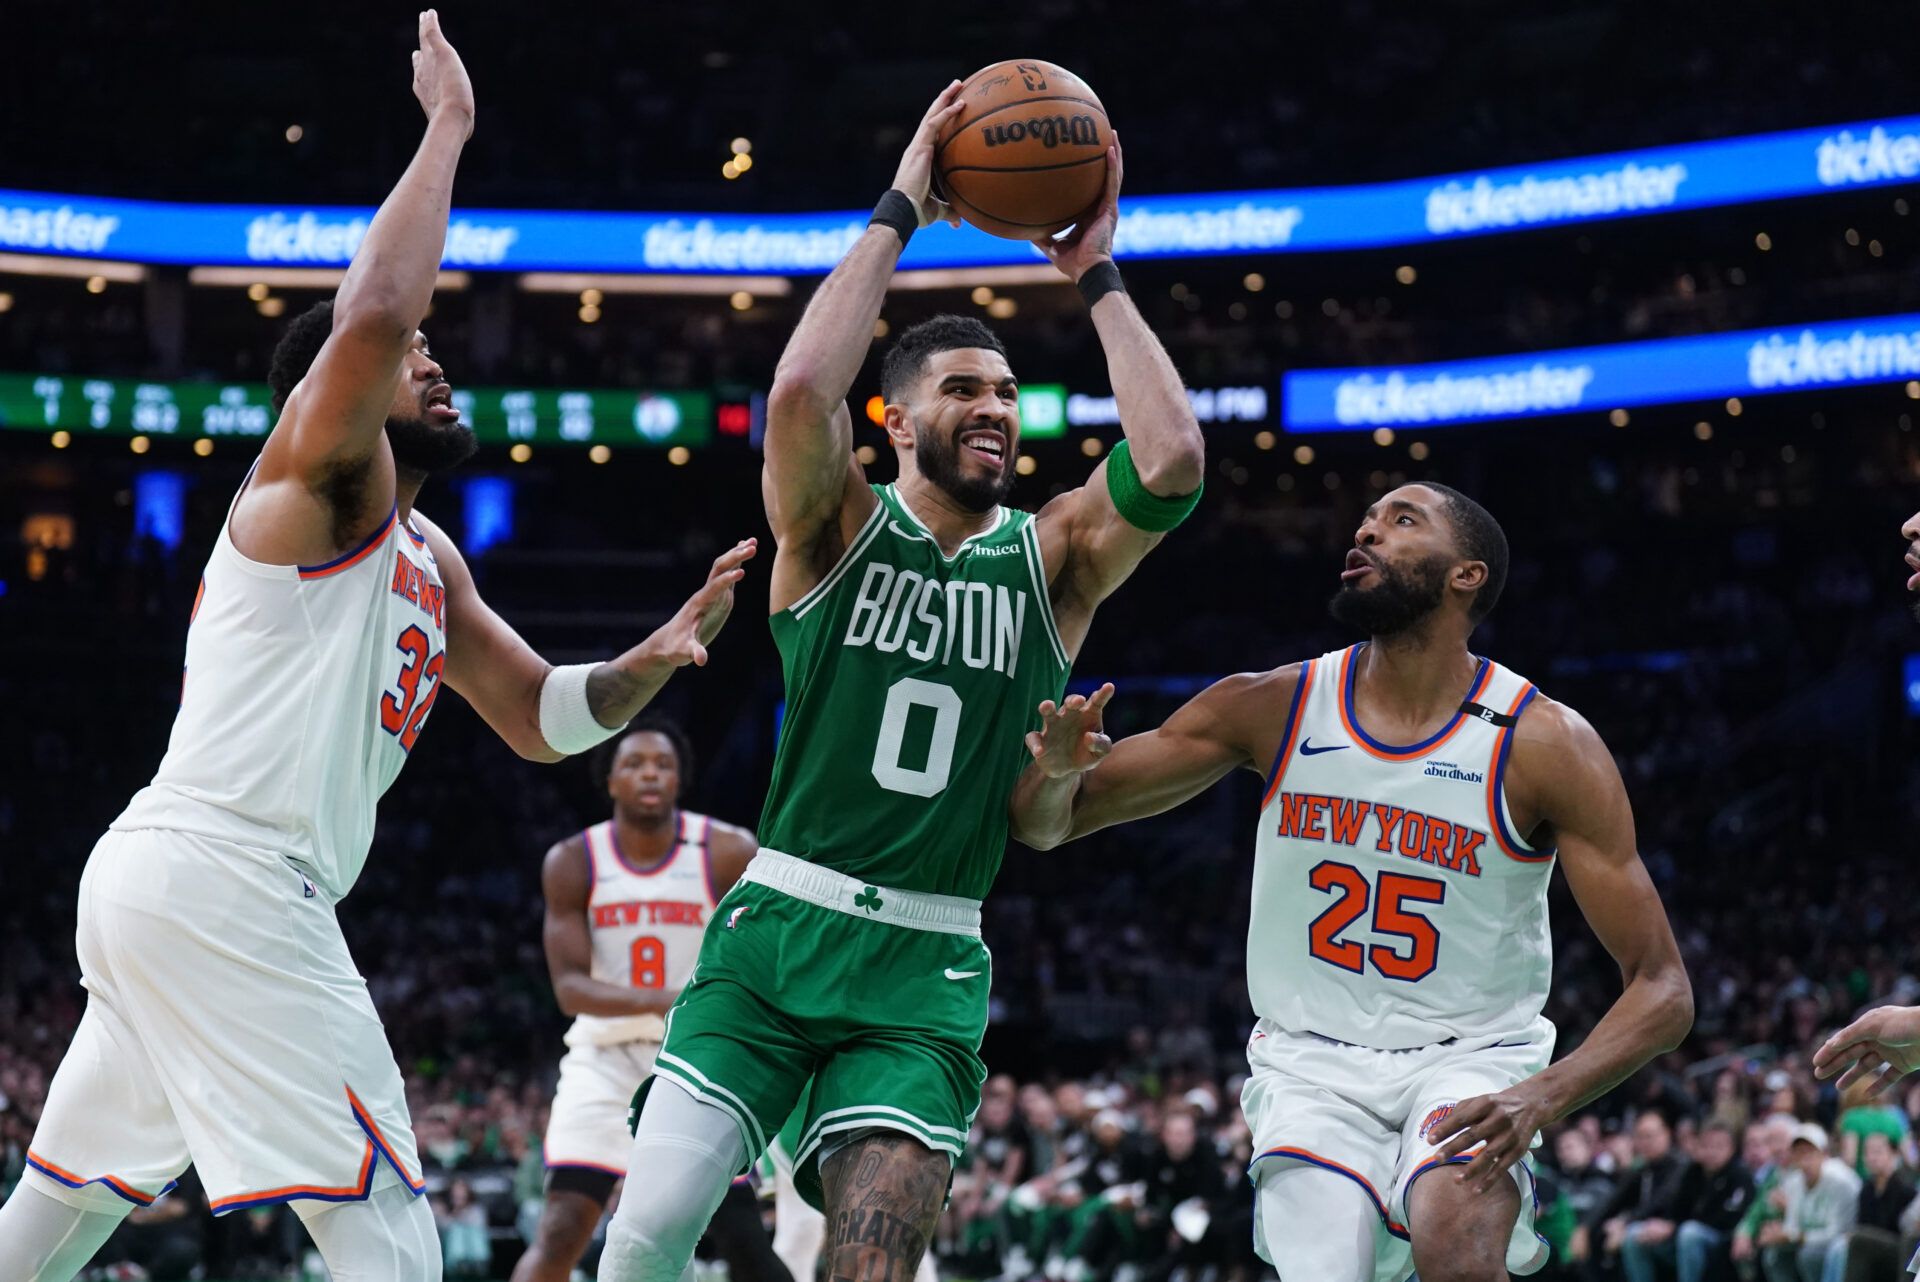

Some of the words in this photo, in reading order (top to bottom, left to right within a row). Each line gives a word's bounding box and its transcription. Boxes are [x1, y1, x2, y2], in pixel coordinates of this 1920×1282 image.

[982, 113, 1101, 149] Wilson
[1424, 162, 1686, 235] ticketmaster
[1334, 362, 1593, 427] ticketmaster
[966, 543, 1021, 559] Amica
[843, 562, 1027, 679] BOSTON
[380, 623, 445, 754] 32
[1480, 708, 1494, 722] 12
[872, 677, 963, 798] 0
[1424, 766, 1448, 778] abu
[1448, 769, 1483, 784] dhabi
[1278, 792, 1371, 847] NEW
[1372, 802, 1486, 877] YORK
[591, 902, 642, 928] NEW
[646, 901, 704, 928] YORK
[1308, 859, 1447, 983] 25
[630, 934, 666, 989] 8
